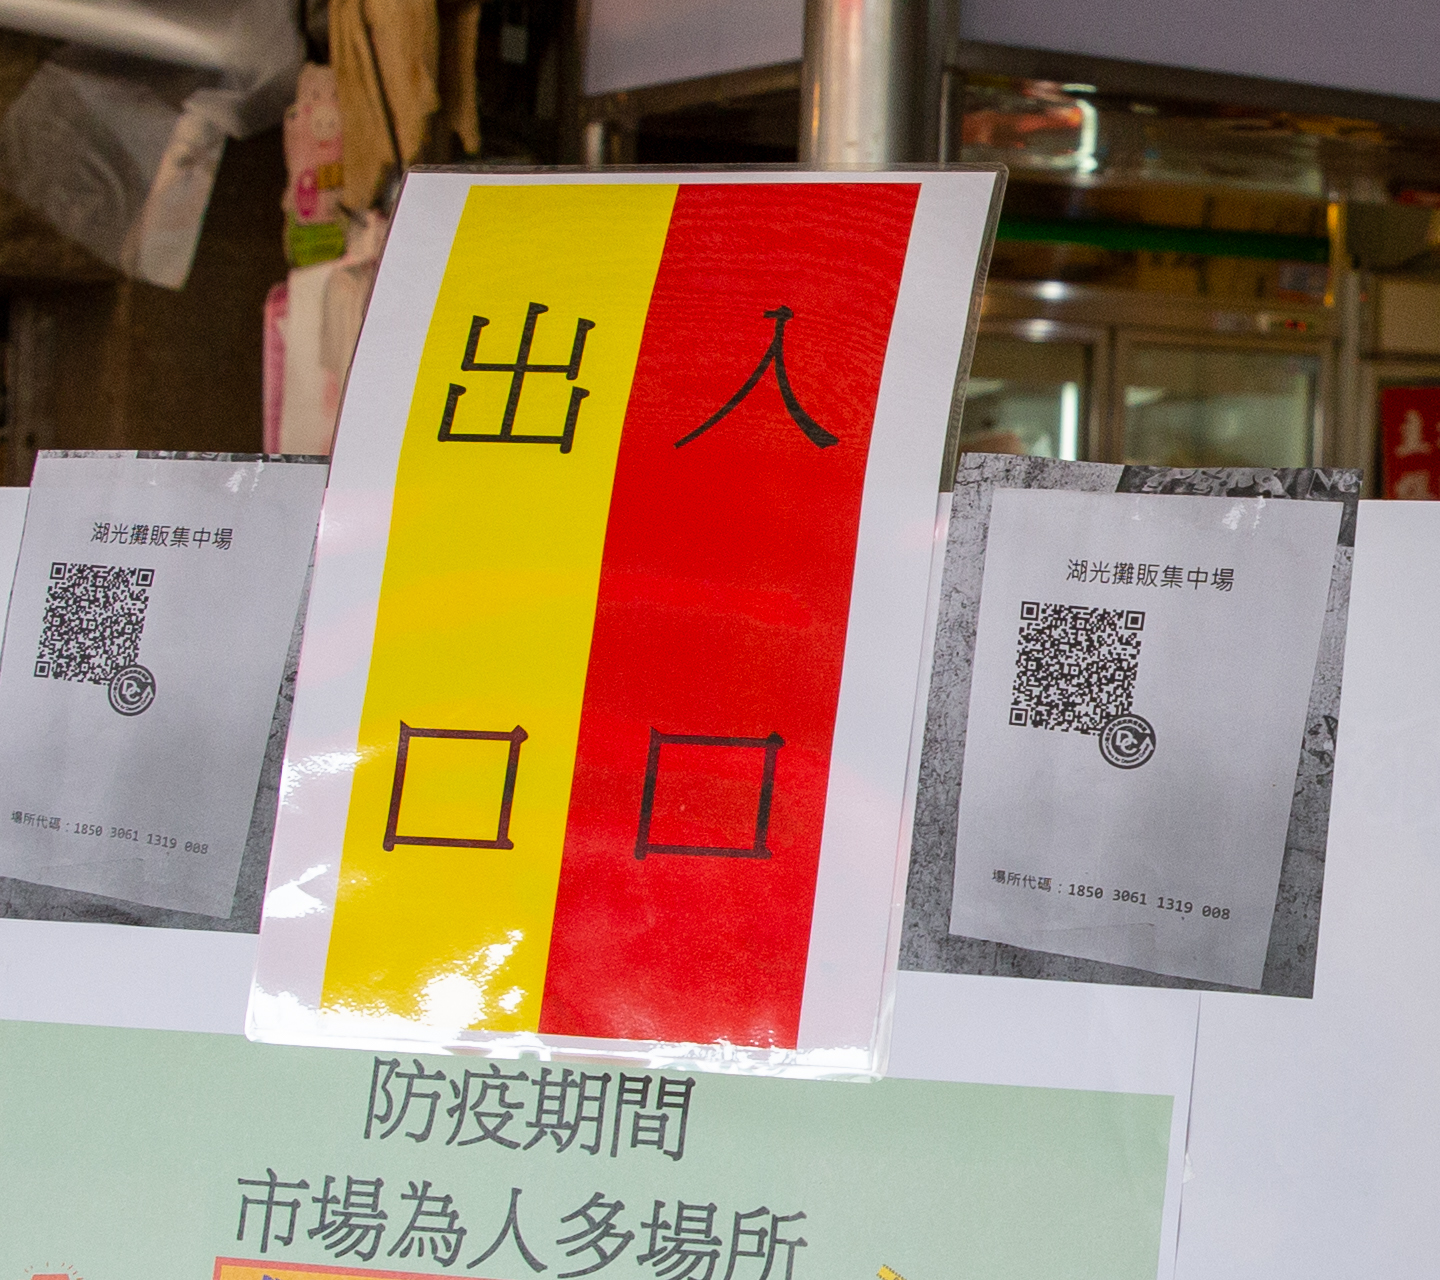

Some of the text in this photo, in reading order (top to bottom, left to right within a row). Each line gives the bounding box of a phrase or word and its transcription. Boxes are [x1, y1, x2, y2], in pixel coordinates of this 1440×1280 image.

[90, 522, 234, 550] 湖光攤販集中場
[1066, 558, 1235, 592] 湖光攤販集中場
[110, 826, 140, 842] 3061
[147, 832, 177, 849] 1319
[184, 840, 209, 855] 008
[1112, 889, 1148, 906] 3061
[1157, 896, 1193, 914] 1319
[1201, 905, 1231, 920] 008
[363, 1056, 695, 1161] 防疫期間
